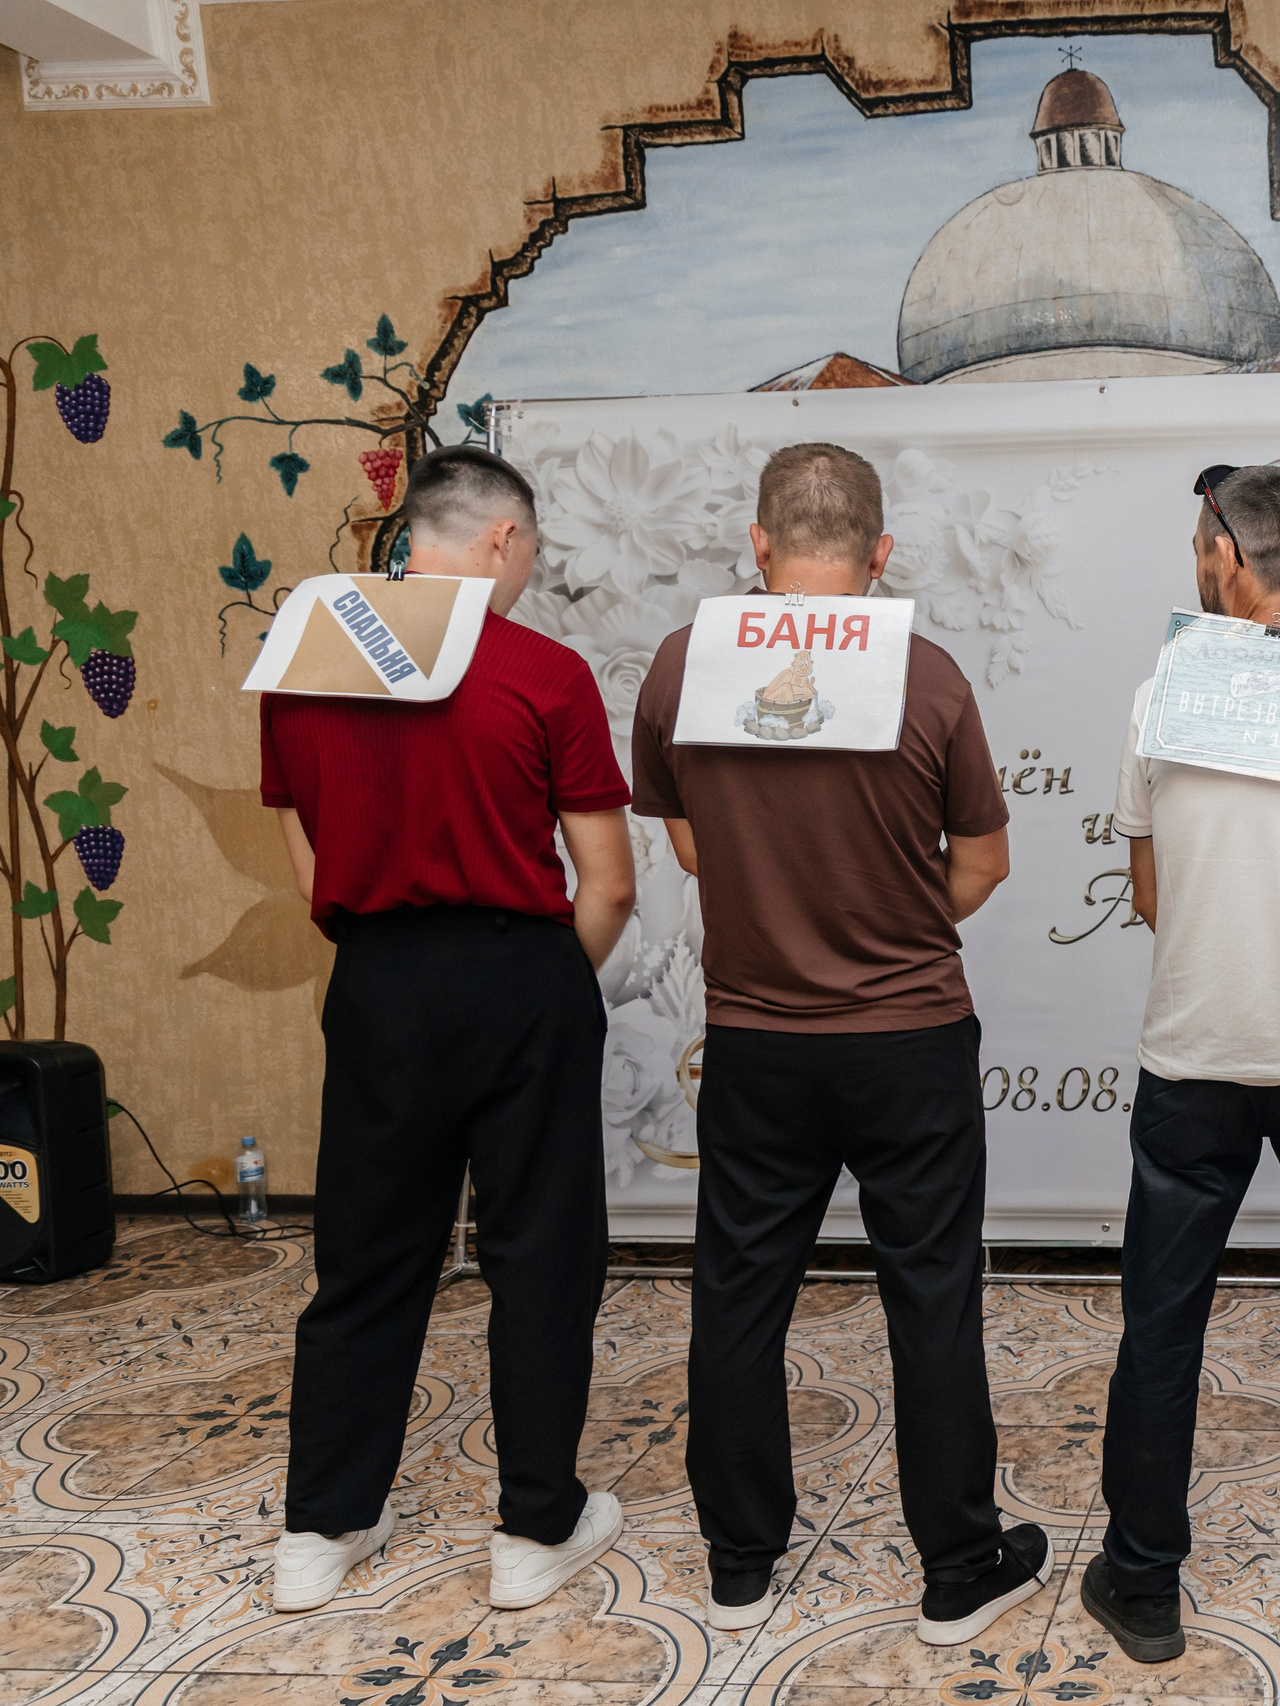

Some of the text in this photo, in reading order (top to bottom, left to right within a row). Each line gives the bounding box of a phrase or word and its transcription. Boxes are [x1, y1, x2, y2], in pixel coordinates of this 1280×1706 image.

[333, 590, 417, 684] СПАЛЬНЯ
[737, 612, 870, 651] БАНЯ
[1081, 813, 1116, 845] и
